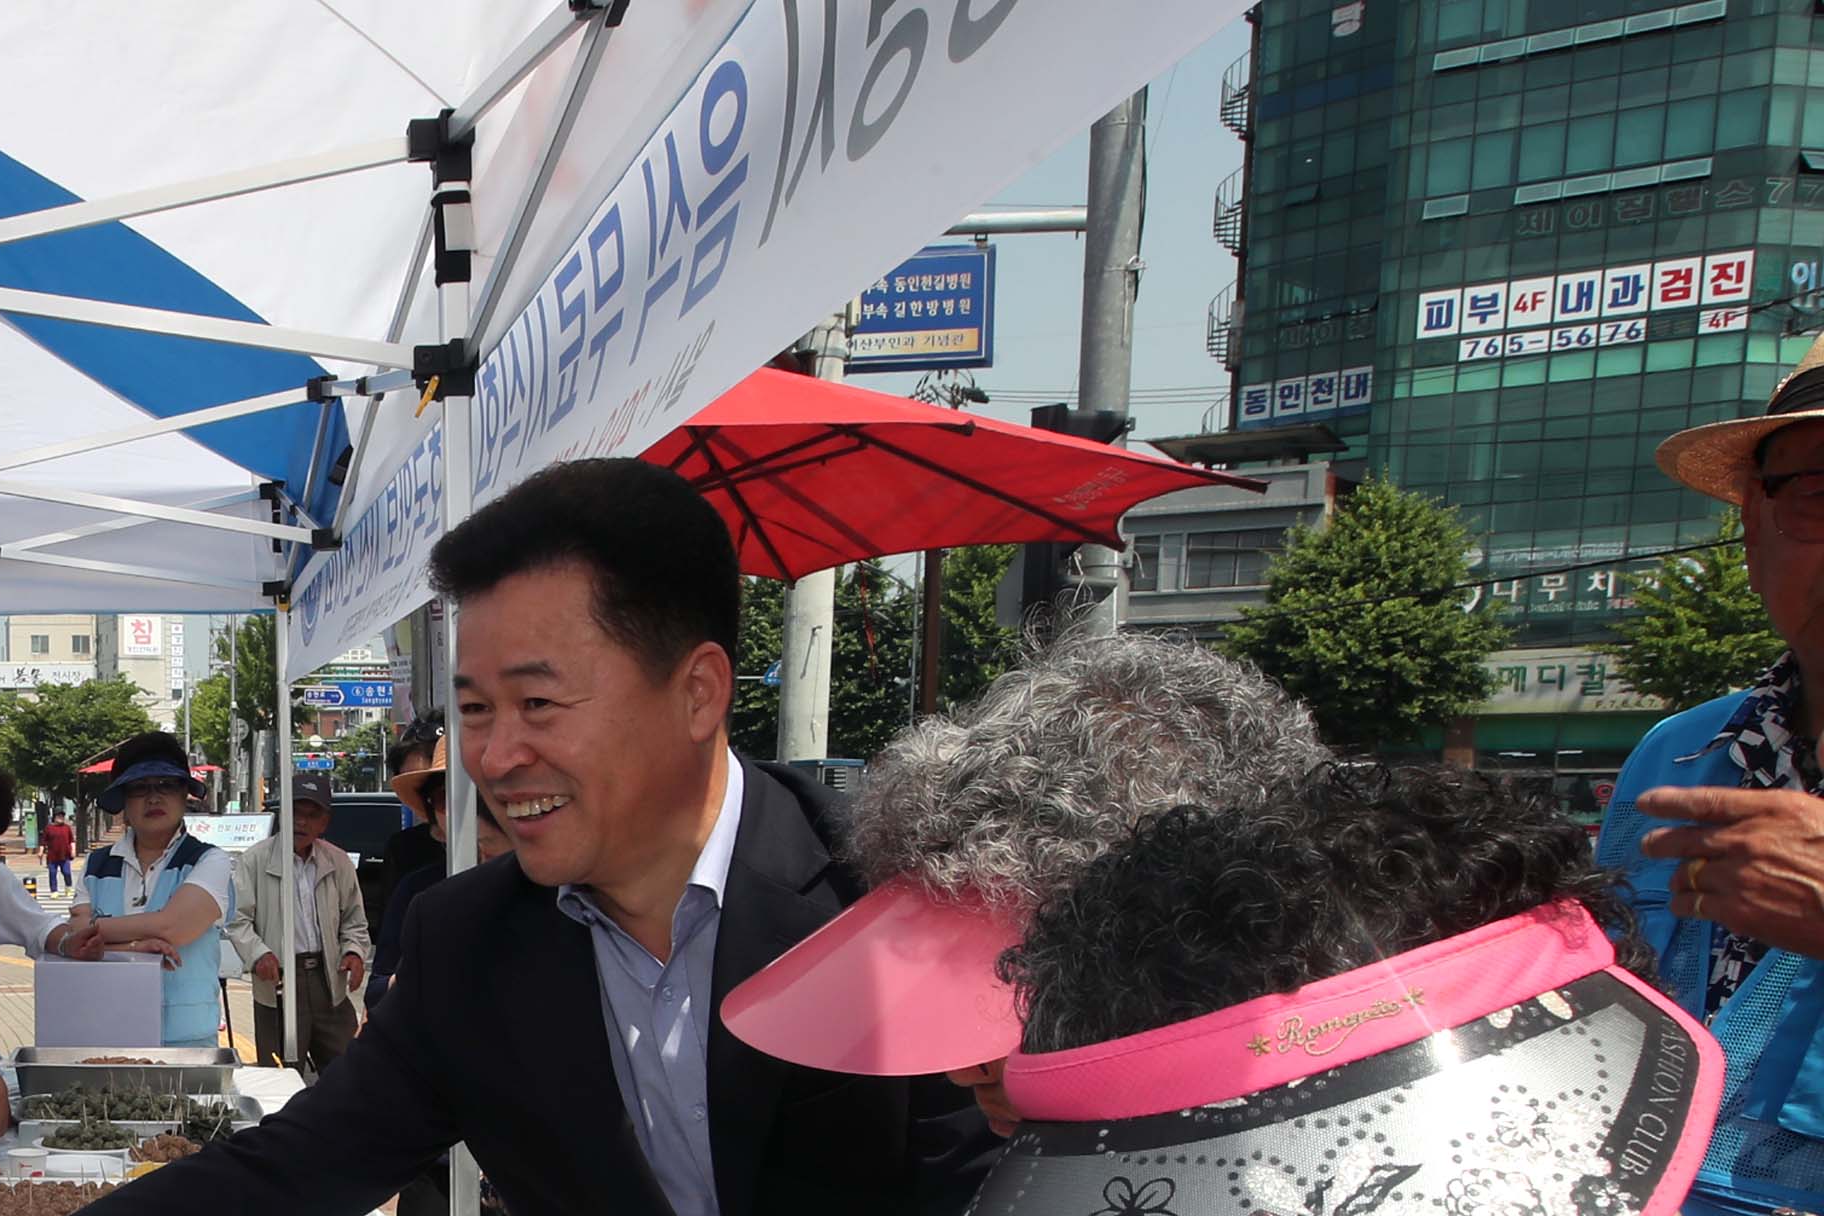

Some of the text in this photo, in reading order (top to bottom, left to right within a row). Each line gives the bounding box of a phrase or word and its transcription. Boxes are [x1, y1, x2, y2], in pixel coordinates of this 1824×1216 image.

[894, 272, 972, 293] 동인천길병원
[1424, 261, 1745, 331] 피부 4F 내과 검진
[863, 303, 889, 320] 부속
[1708, 309, 1736, 329] 4F
[1466, 324, 1642, 358] 765-5676
[1244, 373, 1369, 415] 동인천내
[130, 618, 153, 645] 침
